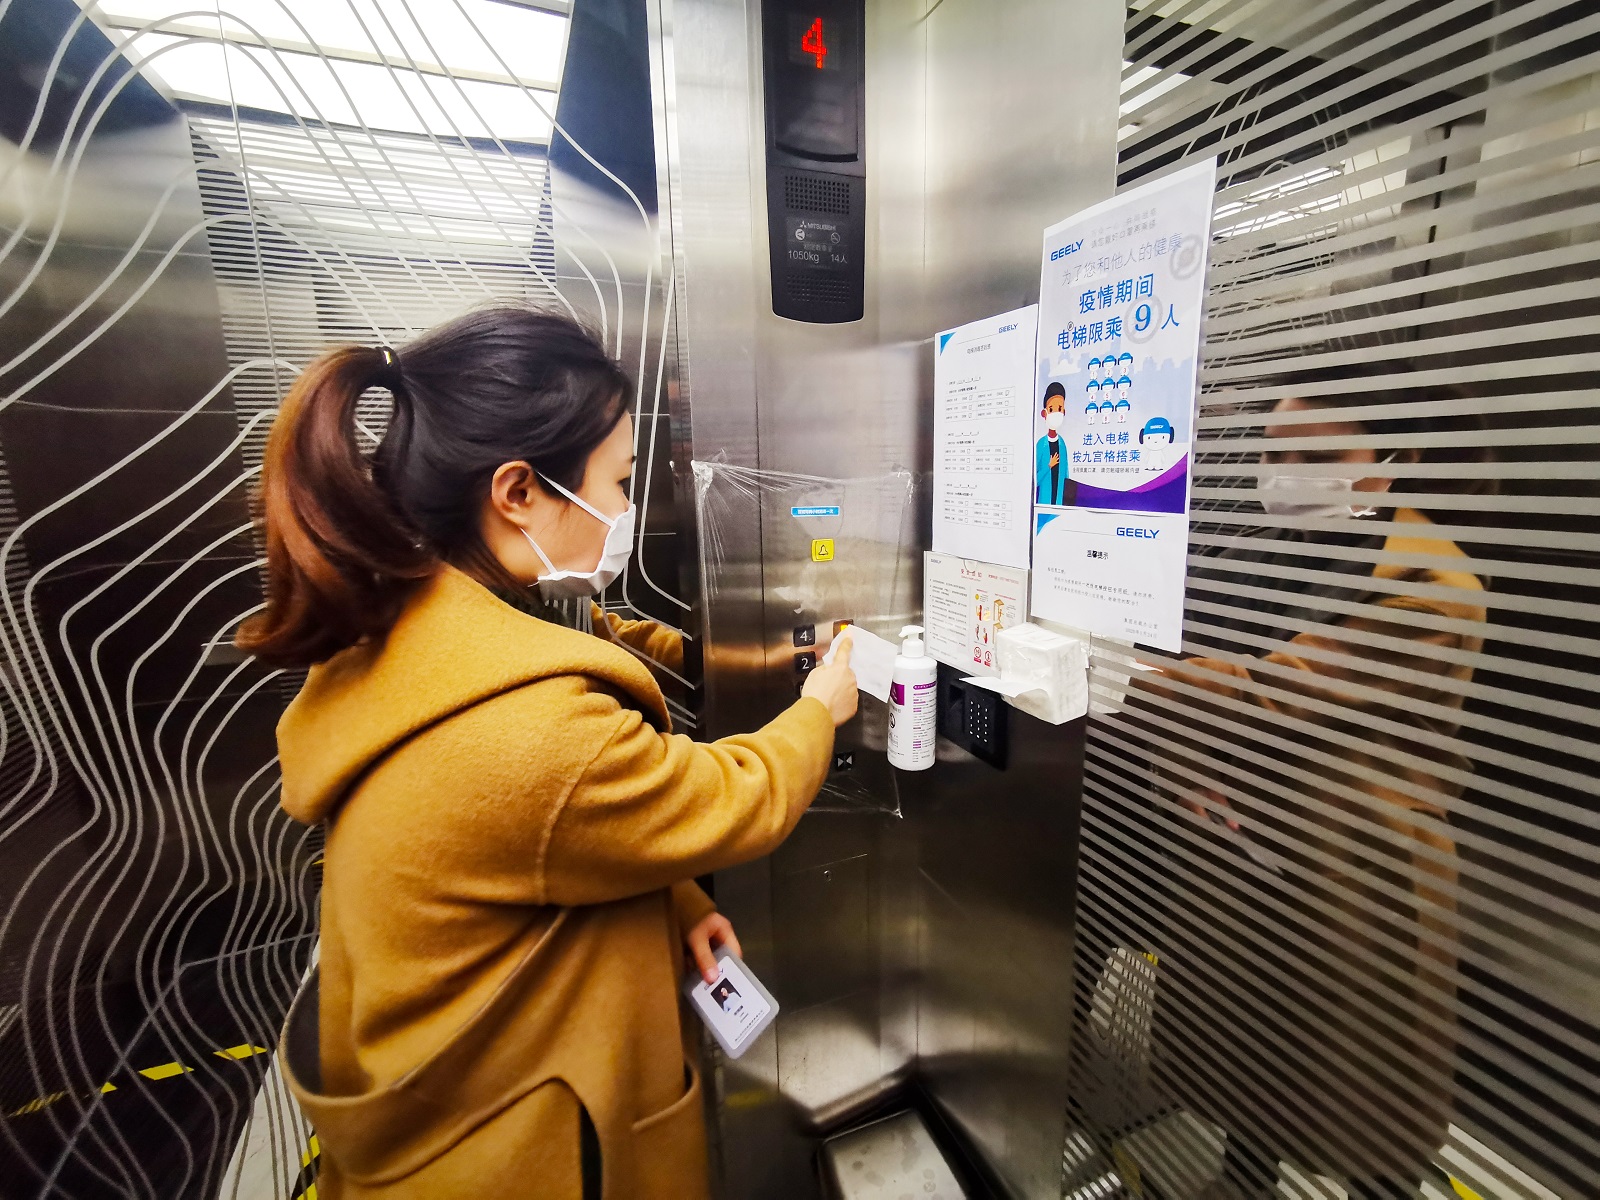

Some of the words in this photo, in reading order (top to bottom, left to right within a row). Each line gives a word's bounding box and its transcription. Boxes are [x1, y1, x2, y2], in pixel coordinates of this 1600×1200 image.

[802, 17, 827, 69] 4
[788, 250, 820, 264] 1050kg
[831, 254, 848, 264] 14人
[1050, 239, 1084, 262] GEELY
[1062, 232, 1182, 286] 为了您和他人的健康
[1079, 273, 1154, 314] 疫情期间
[998, 323, 1018, 334] GEELY
[1058, 316, 1122, 350] 电梯限乘
[1135, 304, 1152, 332] 9
[1161, 304, 1180, 330] 人
[1082, 432, 1130, 446] 进入电梯
[1072, 450, 1142, 463] 按九宫格搭乘
[1116, 527, 1160, 539] GEELY
[800, 630, 808, 642] 4
[802, 658, 810, 670] 2
